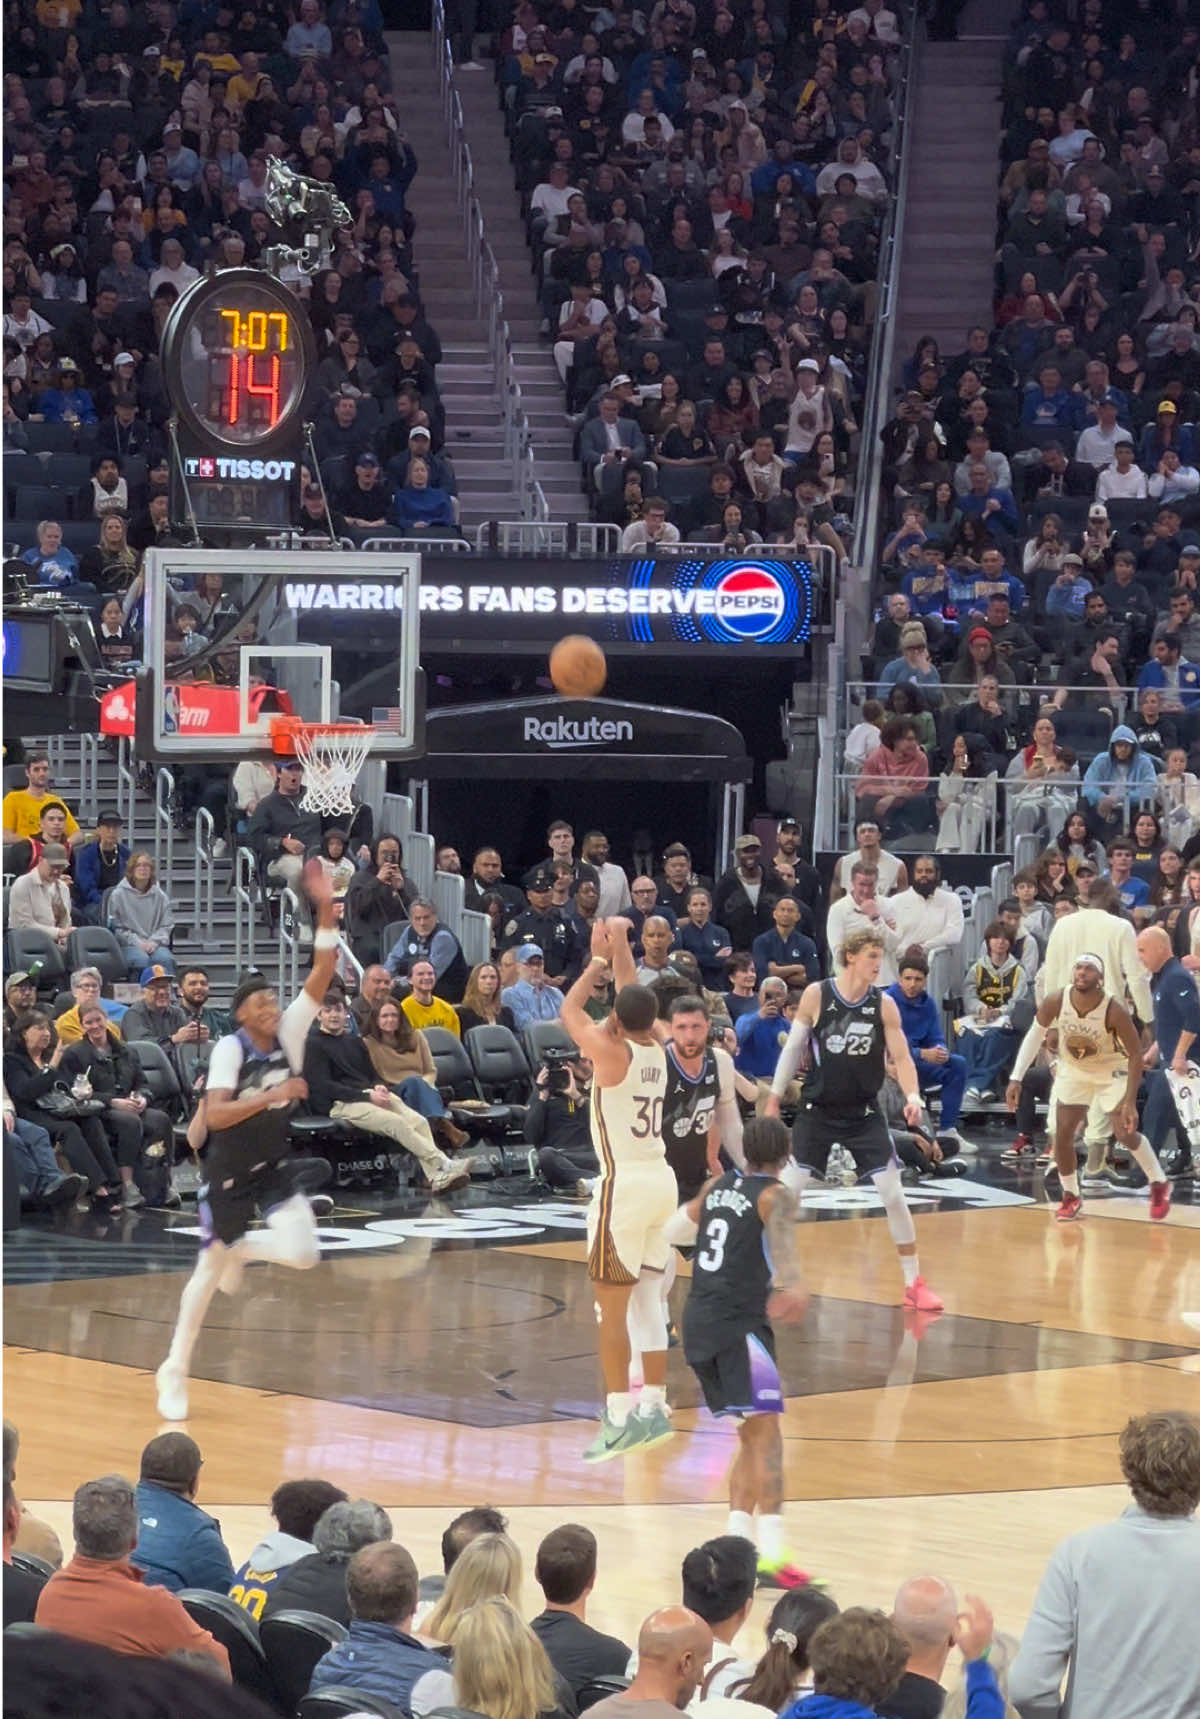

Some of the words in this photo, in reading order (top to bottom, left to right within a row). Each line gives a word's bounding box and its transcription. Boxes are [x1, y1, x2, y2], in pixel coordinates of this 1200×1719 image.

[221, 310, 288, 351] 7:07
[229, 354, 279, 427] 14
[216, 458, 295, 480] TISSOT
[285, 583, 463, 611] WARRIRS
[468, 586, 560, 613] FANS
[562, 587, 715, 614] DESERVE
[720, 595, 779, 609] PEPSI
[180, 702, 210, 726] arm
[523, 715, 634, 741] Rakuten
[847, 1035, 872, 1055] 23
[630, 1095, 664, 1138] 30
[698, 1217, 729, 1272] 3
